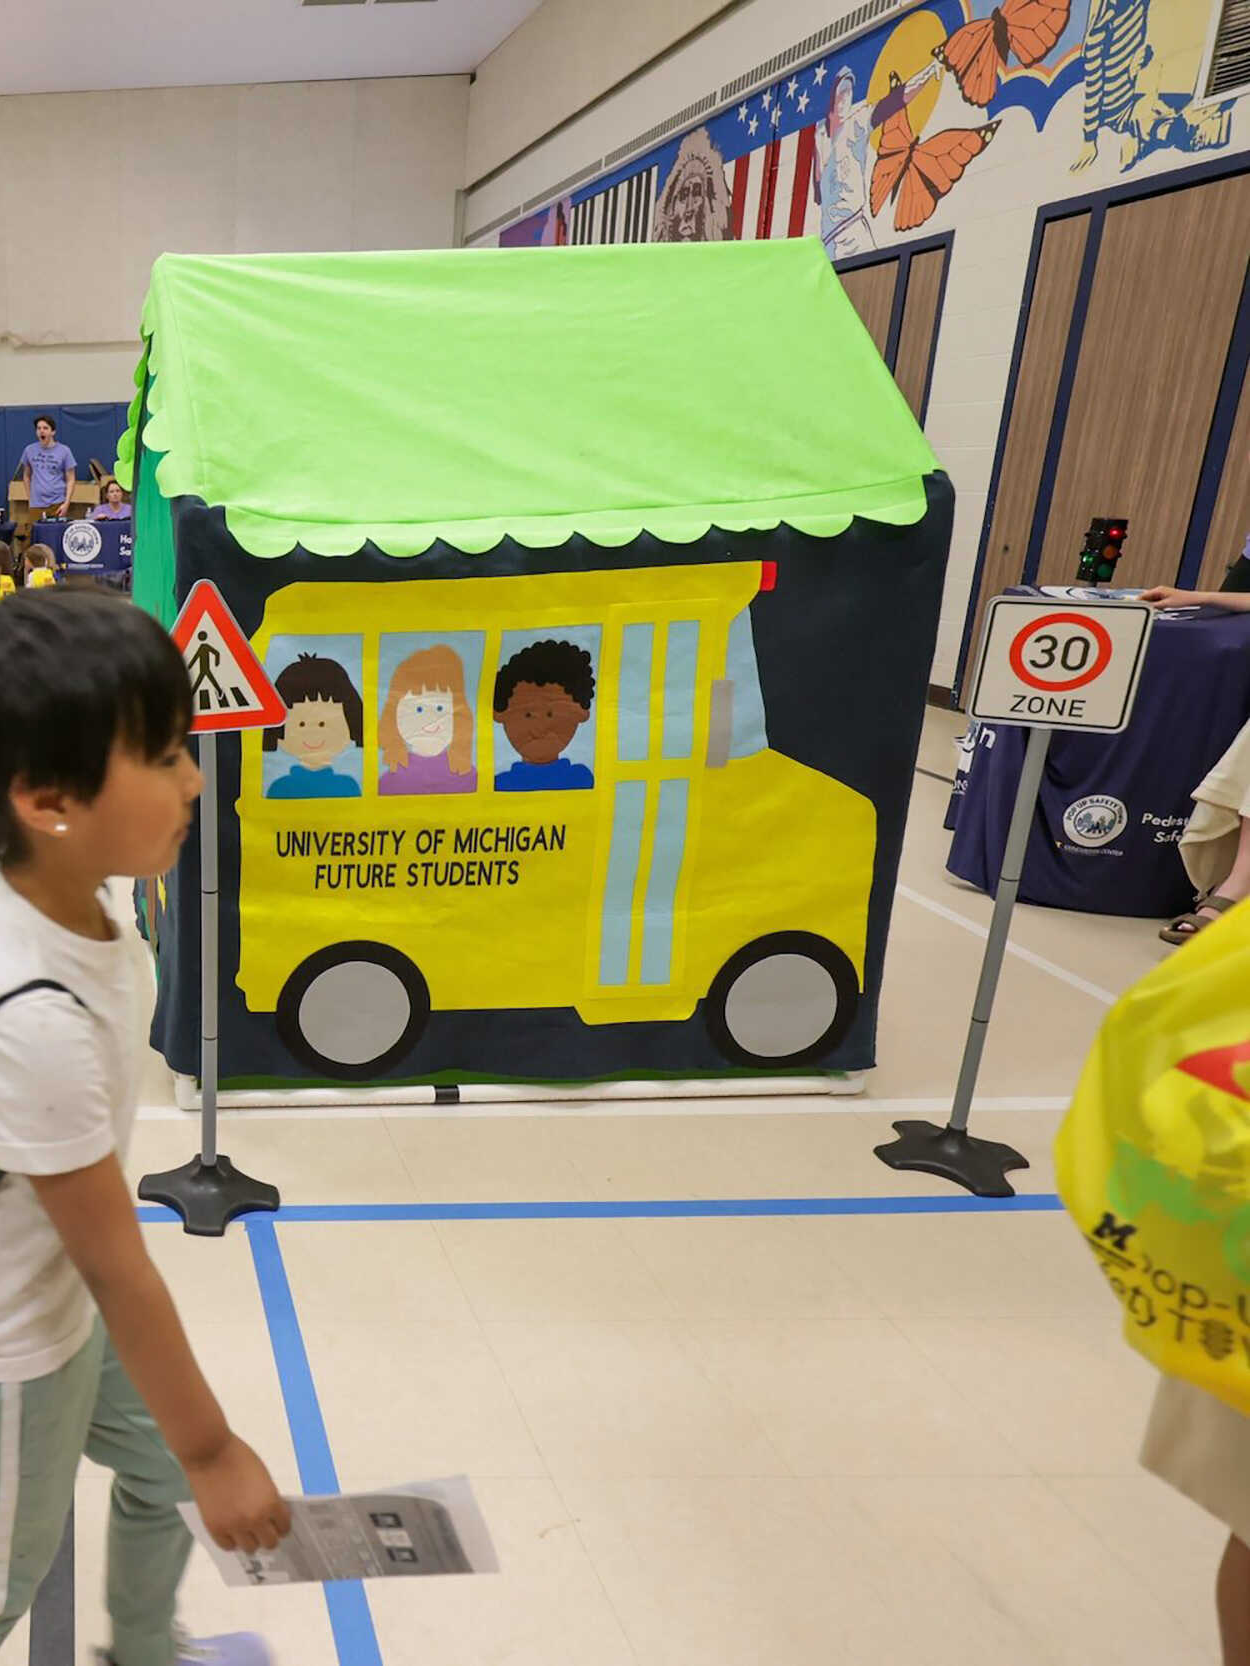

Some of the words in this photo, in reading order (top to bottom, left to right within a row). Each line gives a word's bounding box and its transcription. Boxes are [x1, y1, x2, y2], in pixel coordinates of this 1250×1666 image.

[1028, 634, 1091, 671] 30
[1009, 694, 1087, 718] ZONE
[1089, 797, 1119, 809] SAFETY
[276, 829, 406, 857] UNIVERSITY
[415, 828, 446, 855] OF
[453, 824, 567, 854] MICHIGAN
[314, 863, 398, 890] FUTURE
[406, 860, 521, 888] STUDENTS
